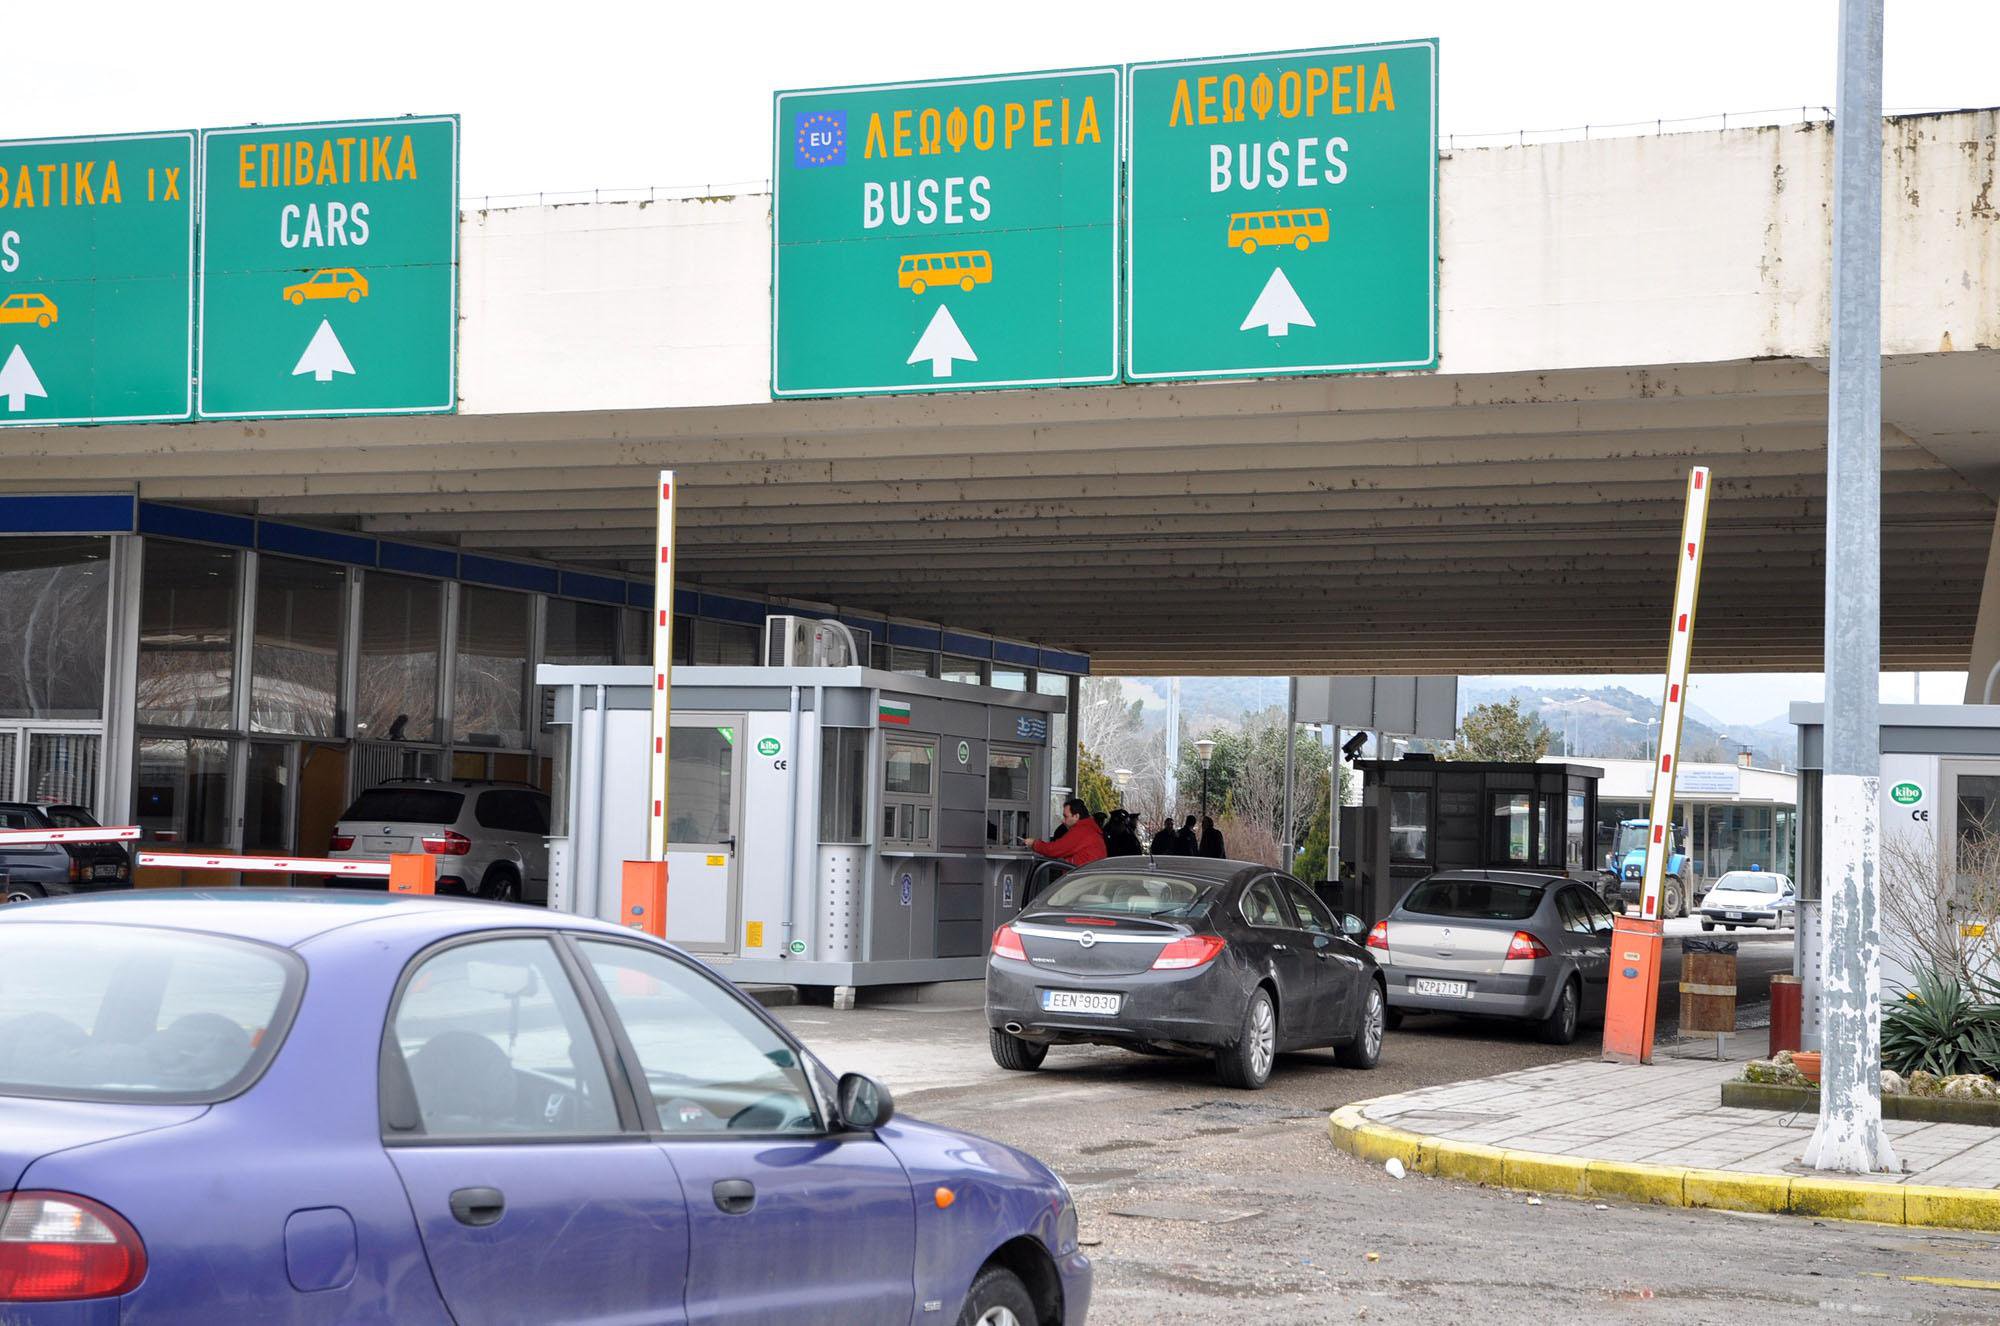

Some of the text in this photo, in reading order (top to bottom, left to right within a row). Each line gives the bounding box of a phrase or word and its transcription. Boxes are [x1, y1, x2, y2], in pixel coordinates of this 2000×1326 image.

[1169, 62, 1395, 127] ΛΕΩΦΟΡΕΙΑ
[810, 131, 832, 146] EU
[864, 96, 1101, 159] ΛΕΩΦΟΡΕΙΑ
[239, 134, 417, 188] ΕΠΙΒΑΤΙΚΑ
[1210, 136, 1349, 193] BUSES
[280, 201, 370, 249] CARS
[863, 175, 991, 229] BUSES
[1895, 786, 1920, 798] kibo
[1912, 810, 1928, 821] CE
